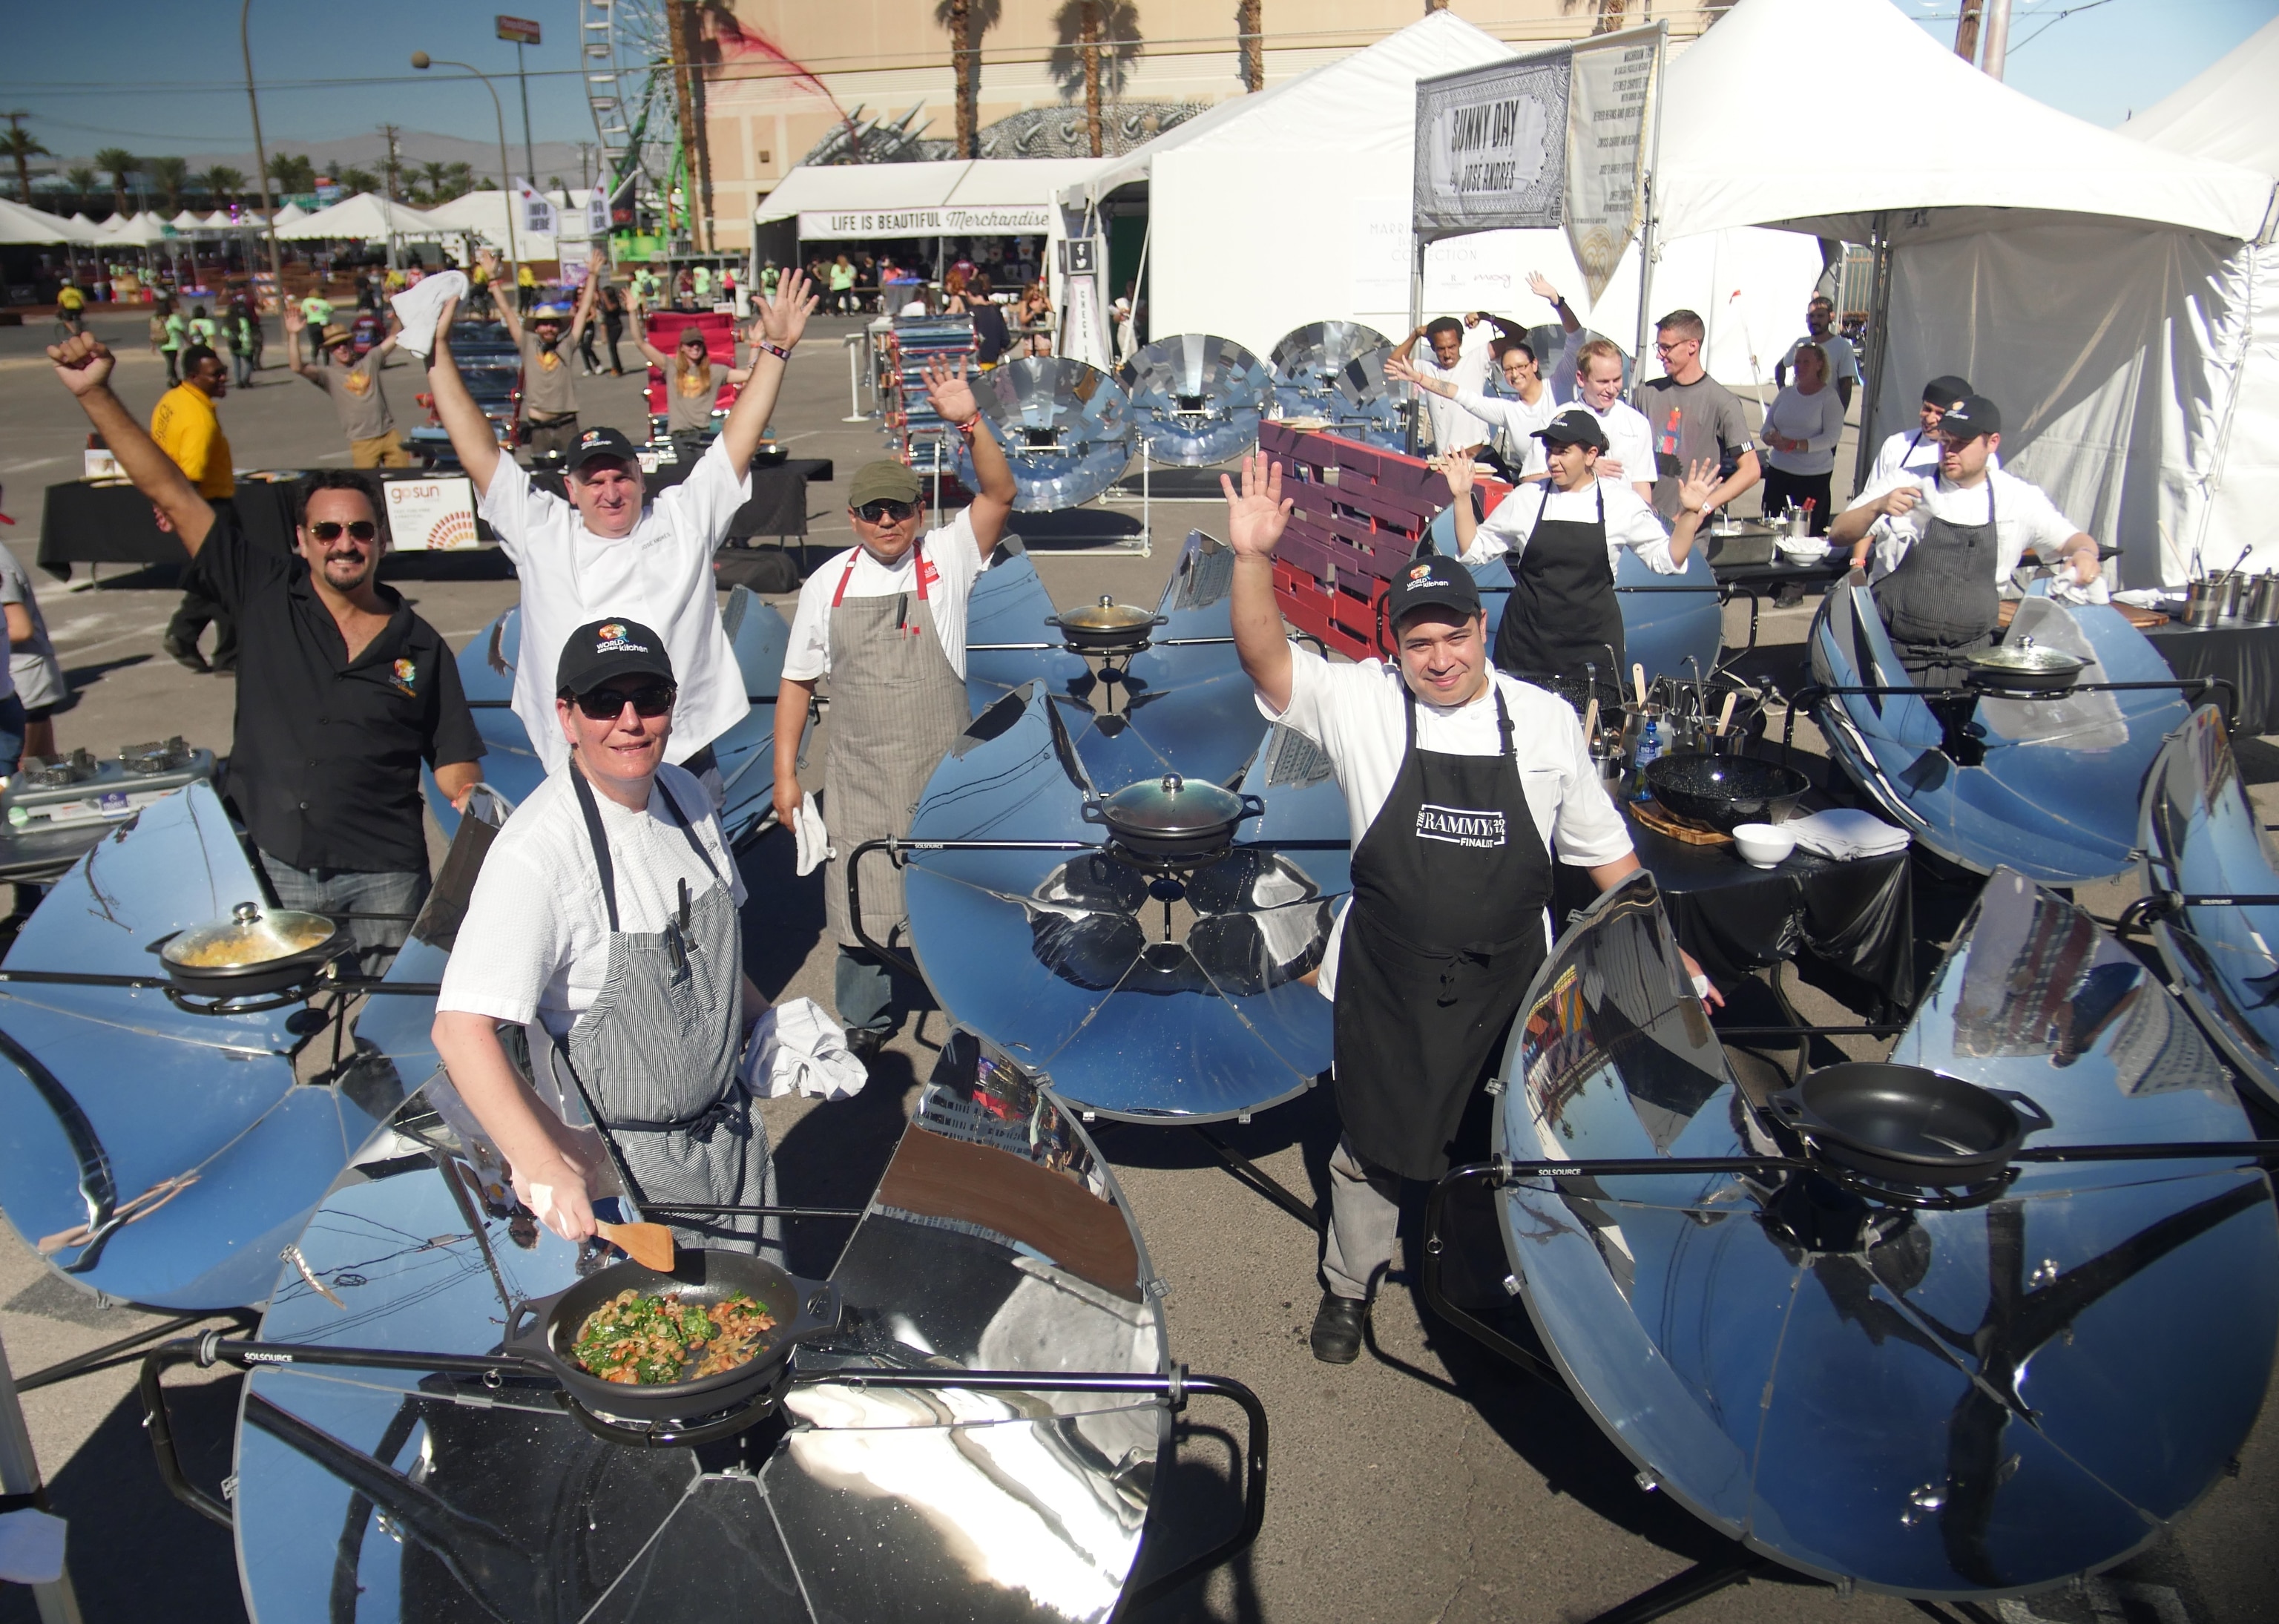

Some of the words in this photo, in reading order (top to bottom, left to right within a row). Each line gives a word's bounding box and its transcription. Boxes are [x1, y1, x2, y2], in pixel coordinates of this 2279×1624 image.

[1452, 104, 1491, 153] SUNNY
[1492, 99, 1519, 148] DAY
[1482, 151, 1516, 191] ANDRÉS
[832, 215, 856, 231] LIFE
[861, 215, 873, 230] IS
[878, 211, 941, 230] BEAUTIFUL
[945, 210, 1050, 231] Merchandise
[1391, 249, 1478, 262] COECTION
[1407, 577, 1428, 589] WORLD
[1422, 579, 1450, 588] kitchen
[596, 639, 625, 650] WORLD
[619, 644, 649, 654] kitchen
[1415, 810, 1425, 828] THE
[1493, 818, 1506, 826] 20
[1494, 825, 1506, 836] 14
[1538, 1168, 1582, 1177] SOLSOURCE
[244, 1352, 294, 1363] SOLSOURCE
